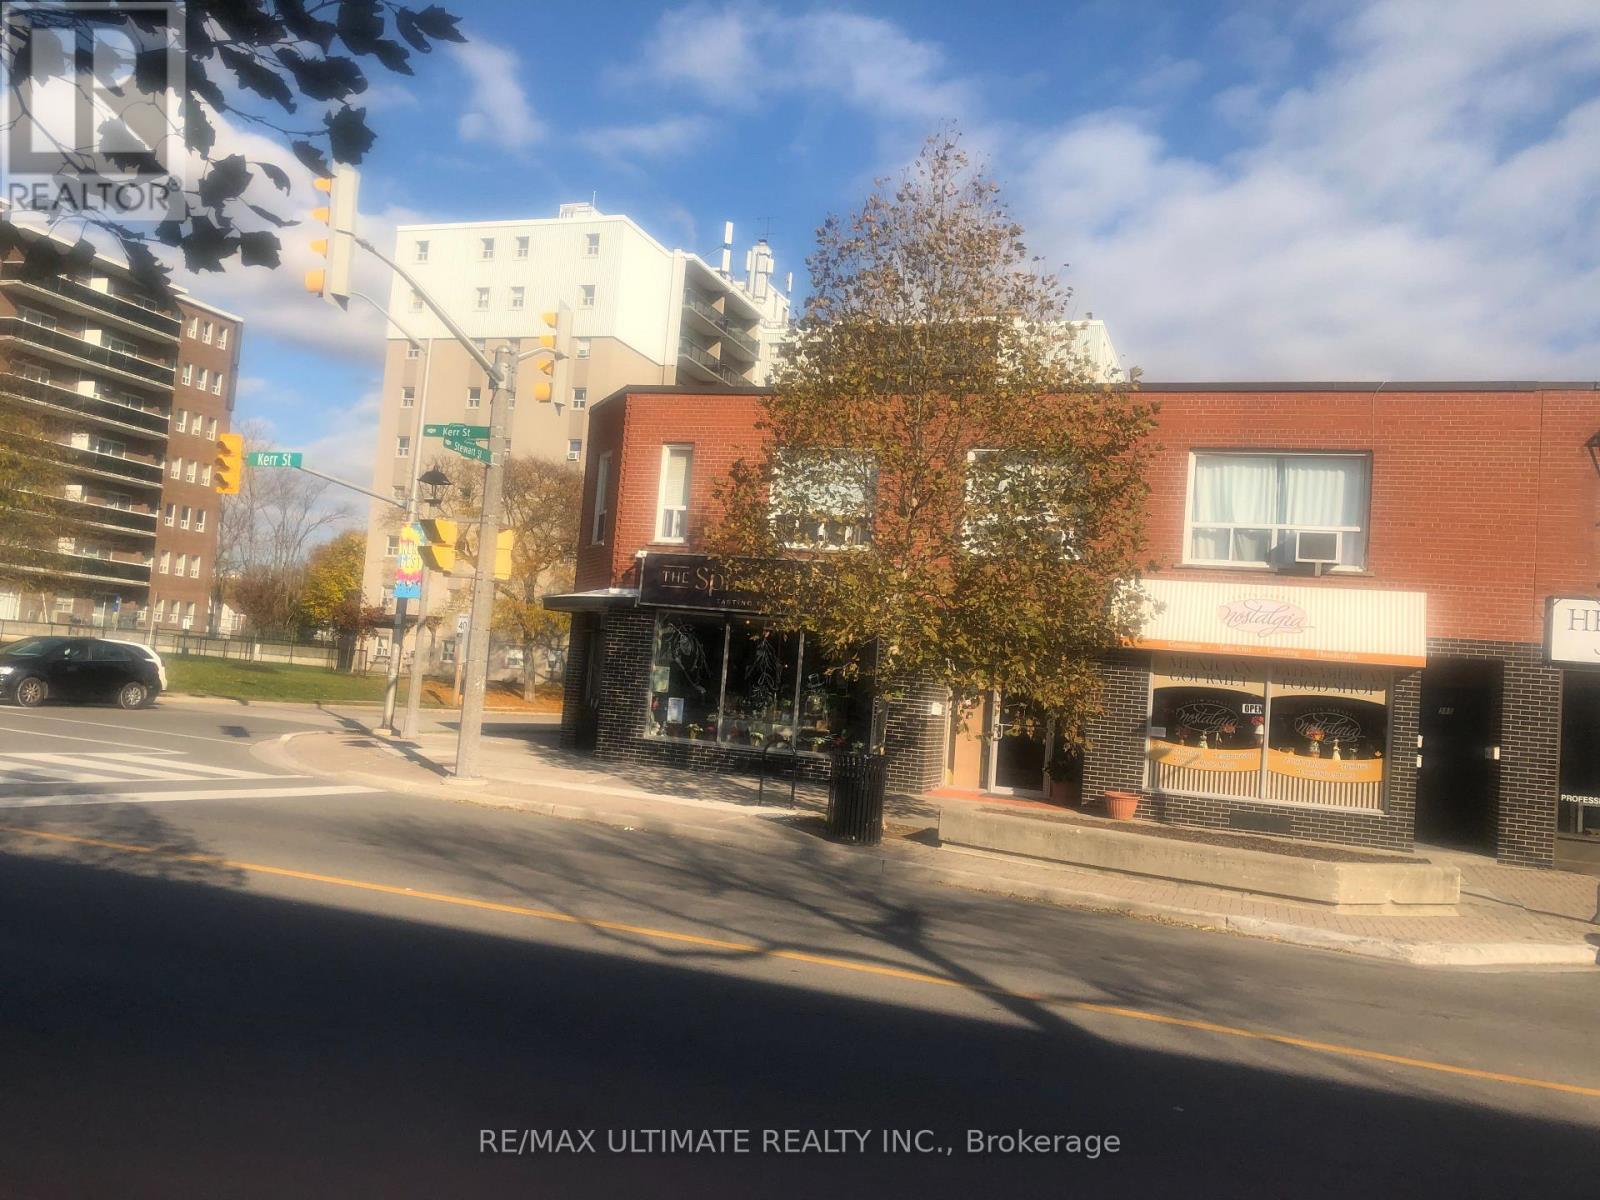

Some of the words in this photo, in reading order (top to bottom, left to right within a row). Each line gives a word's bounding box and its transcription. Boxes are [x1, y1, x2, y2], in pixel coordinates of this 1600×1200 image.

[442, 427, 460, 437] Kerr
[462, 428, 471, 437] St
[454, 441, 476, 456] Stewart
[477, 449, 483, 459] St
[257, 453, 279, 467] Kerr
[281, 453, 292, 467] St
[662, 569, 689, 584] THE
[1168, 671, 1248, 688] GOURMET
[1282, 678, 1329, 693] FOOD
[1333, 681, 1378, 696] SHOP
[1244, 704, 1263, 714] OPEN
